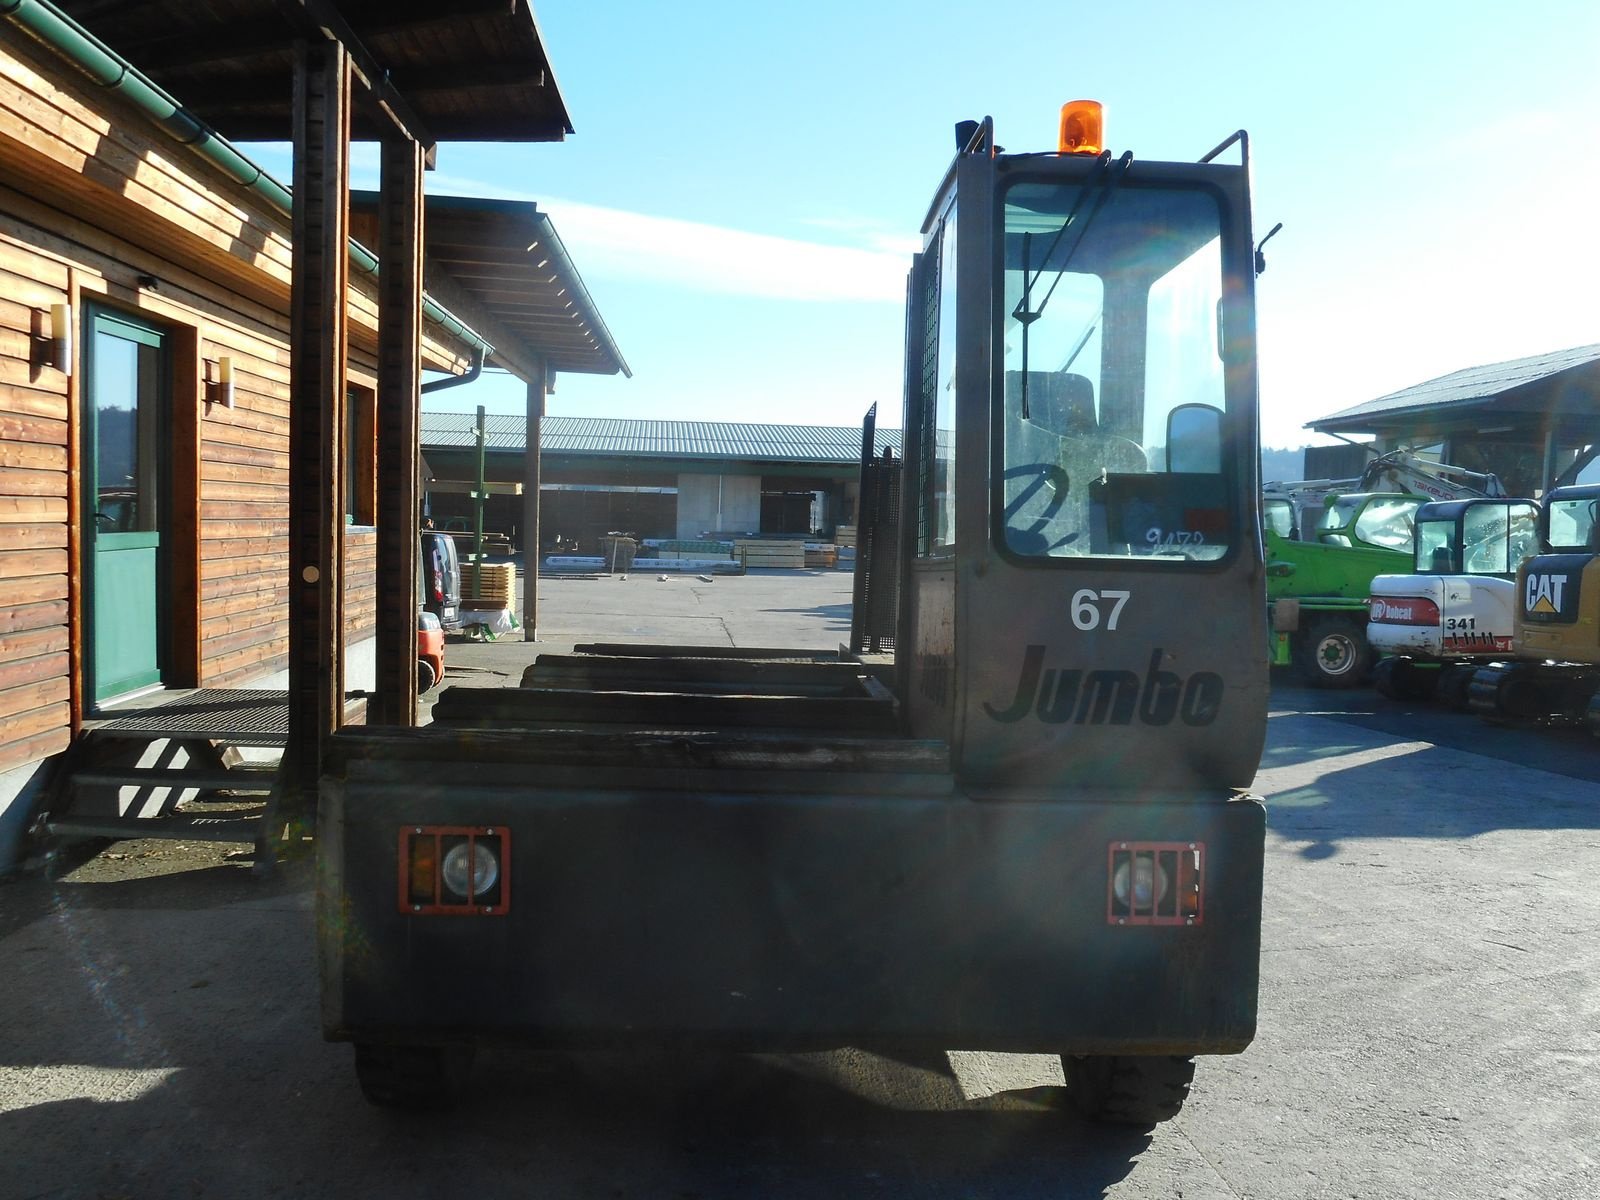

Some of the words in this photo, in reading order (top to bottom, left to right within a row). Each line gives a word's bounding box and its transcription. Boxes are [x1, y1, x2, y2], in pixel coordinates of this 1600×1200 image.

[1070, 589, 1131, 631] 67
[1386, 604, 1412, 620] Bobcat
[1526, 574, 1567, 613] CAT
[1447, 618, 1475, 630] 341
[983, 645, 1225, 727] Jumbo
